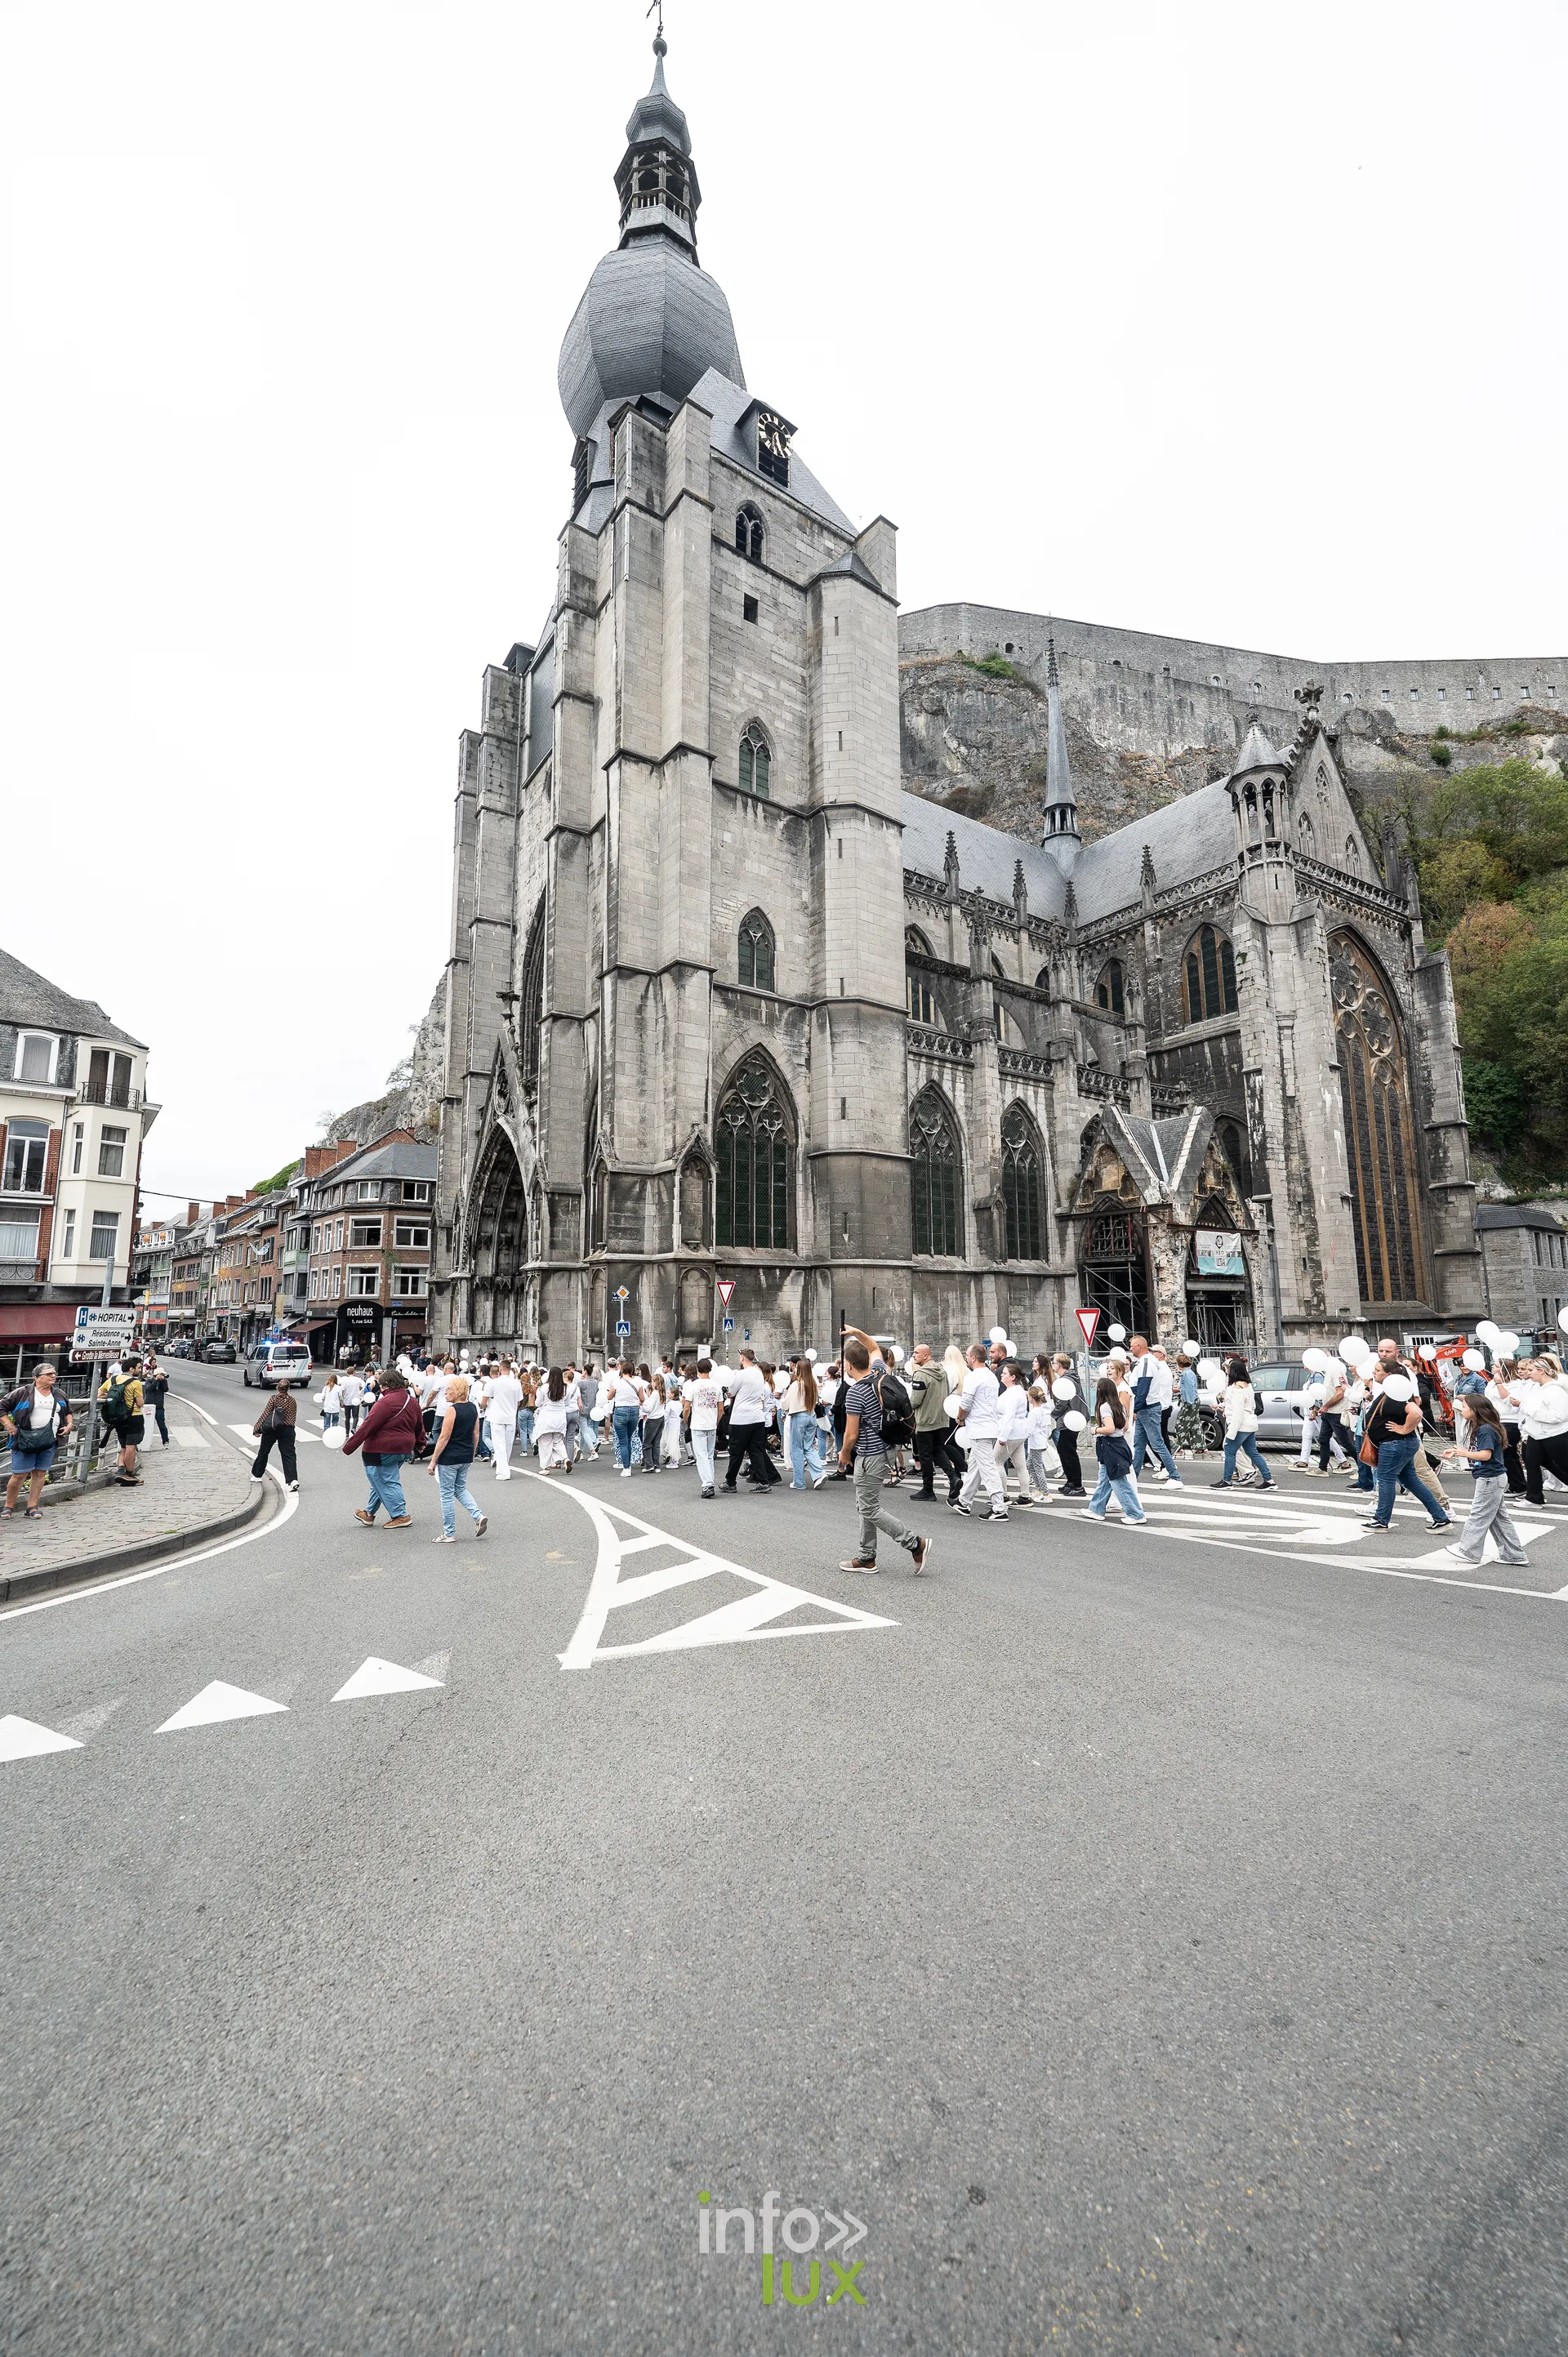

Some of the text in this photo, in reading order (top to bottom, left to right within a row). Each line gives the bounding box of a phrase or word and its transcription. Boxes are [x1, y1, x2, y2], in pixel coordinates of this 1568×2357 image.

[347, 1305, 373, 1316] neuhaus
[80, 1310, 87, 1324] H
[98, 1313, 127, 1322] HOPITAL
[82, 1351, 94, 1360] Grotte
[98, 1350, 120, 1359] Merveilleuse
